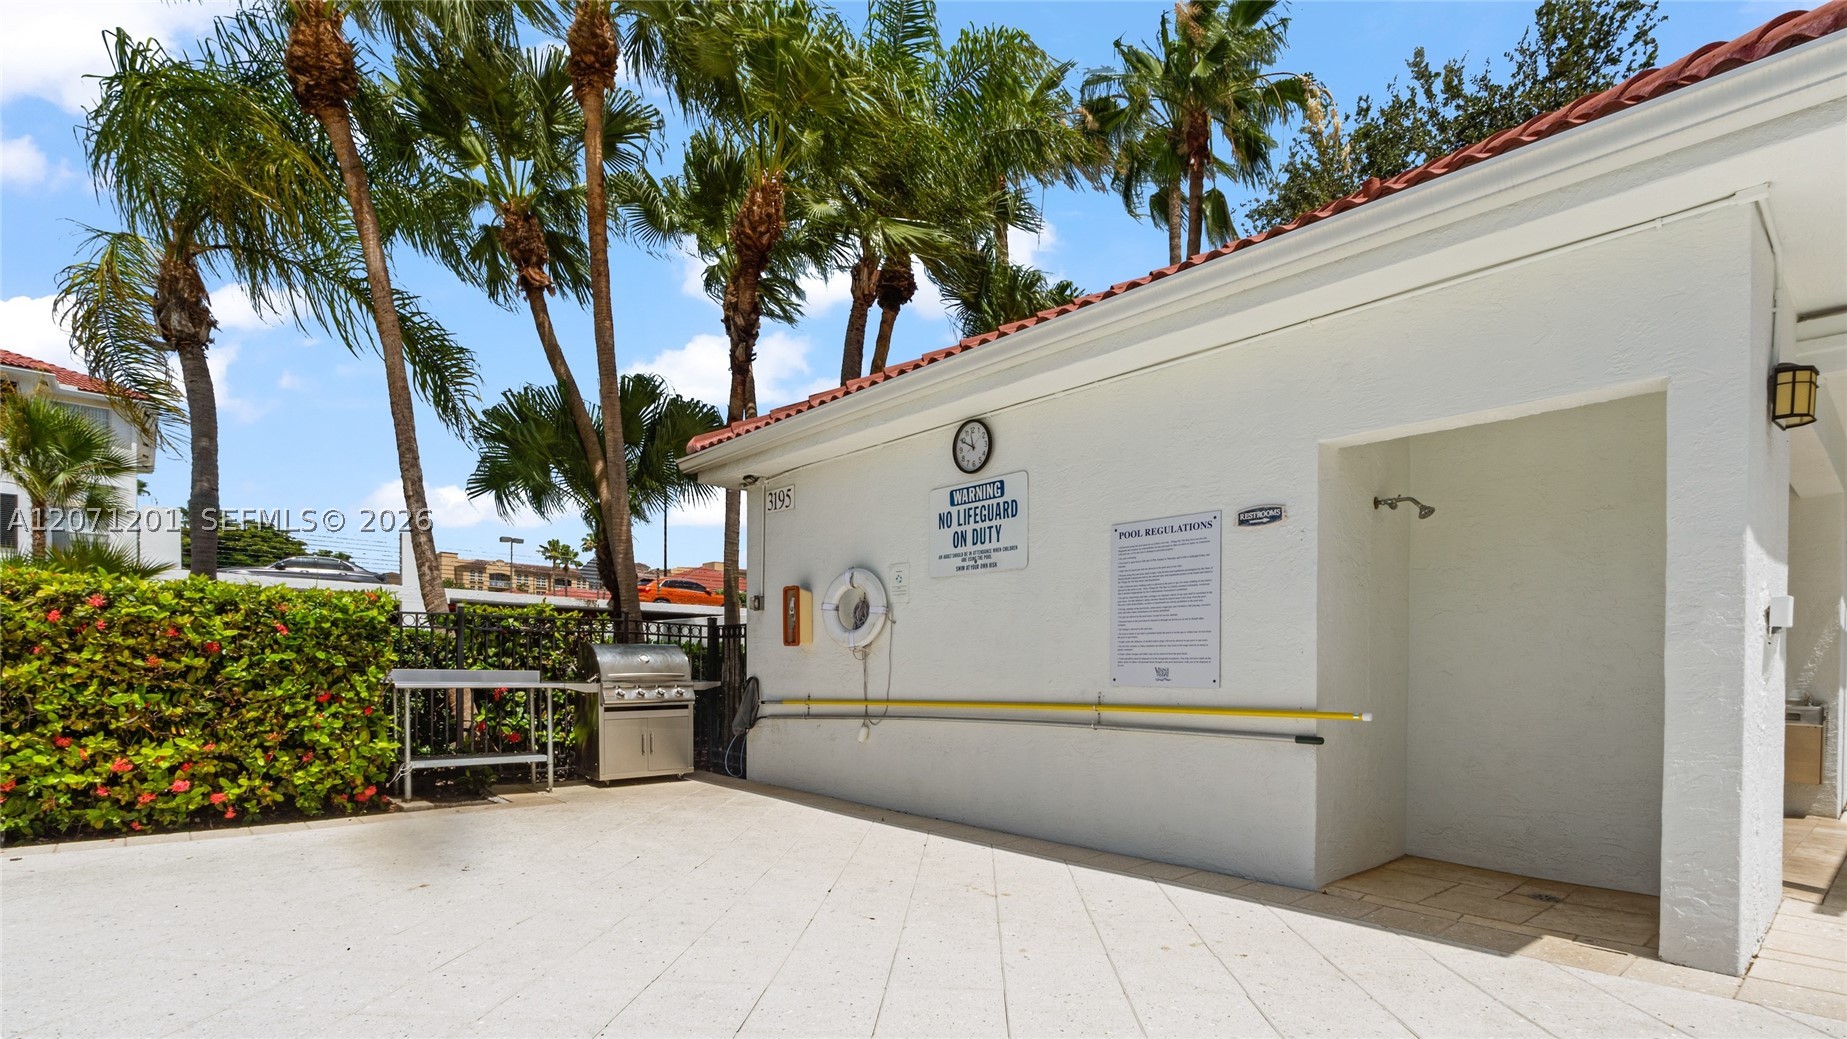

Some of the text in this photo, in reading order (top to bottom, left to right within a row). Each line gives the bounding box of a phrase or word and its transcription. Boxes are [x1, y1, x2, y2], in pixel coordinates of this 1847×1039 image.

[767, 488, 792, 511] 3195
[953, 482, 1001, 504] WARNING
[938, 500, 1018, 530] NO LIFEGUARD
[1240, 509, 1280, 520] RESTROOMS
[953, 524, 1002, 548] ON DUTY
[1119, 520, 1213, 540] POOL REGULATIONS
